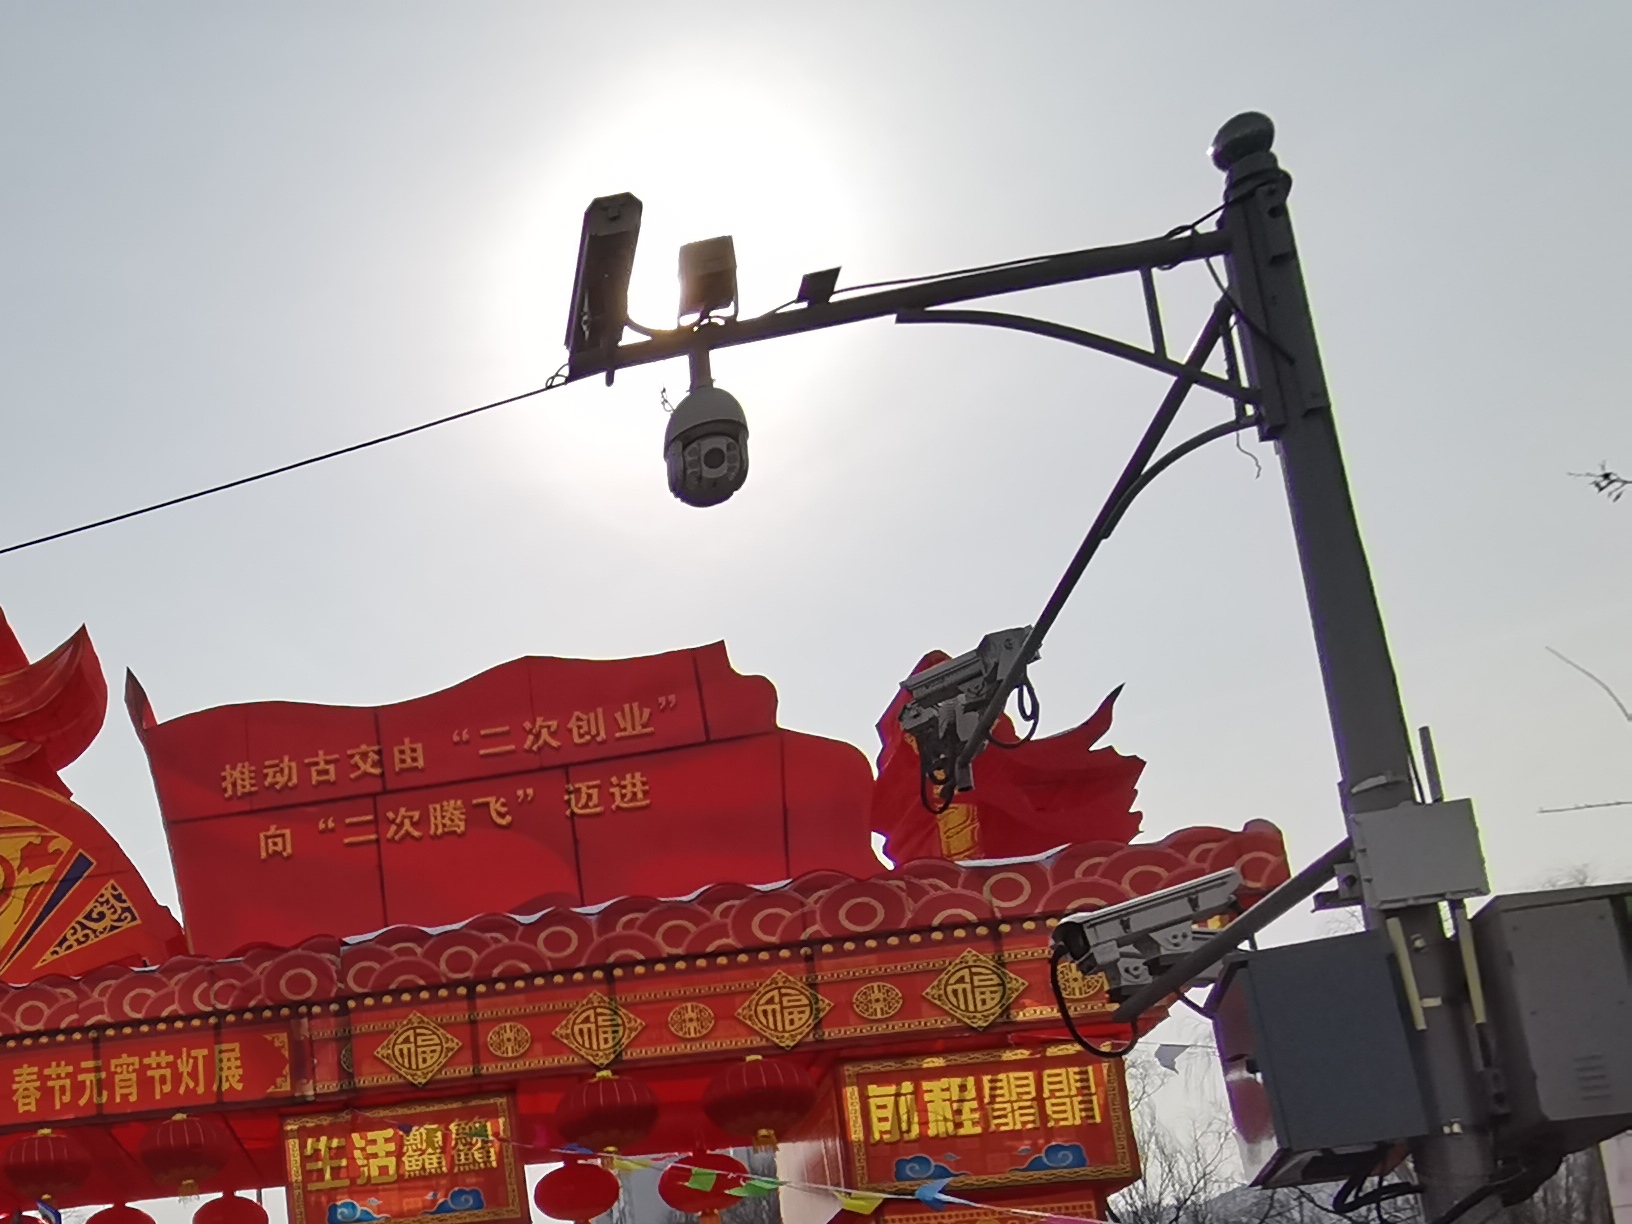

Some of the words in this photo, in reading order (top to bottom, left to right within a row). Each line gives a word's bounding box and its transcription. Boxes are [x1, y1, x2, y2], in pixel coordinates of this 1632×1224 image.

[221, 694, 676, 798] 推动古交由“二次创业”
[259, 772, 651, 859] 向“二次腾飞”迈进
[758, 989, 813, 1031] 福
[947, 967, 1005, 1012] 福
[395, 1028, 442, 1070] 福
[573, 1008, 625, 1050] 福
